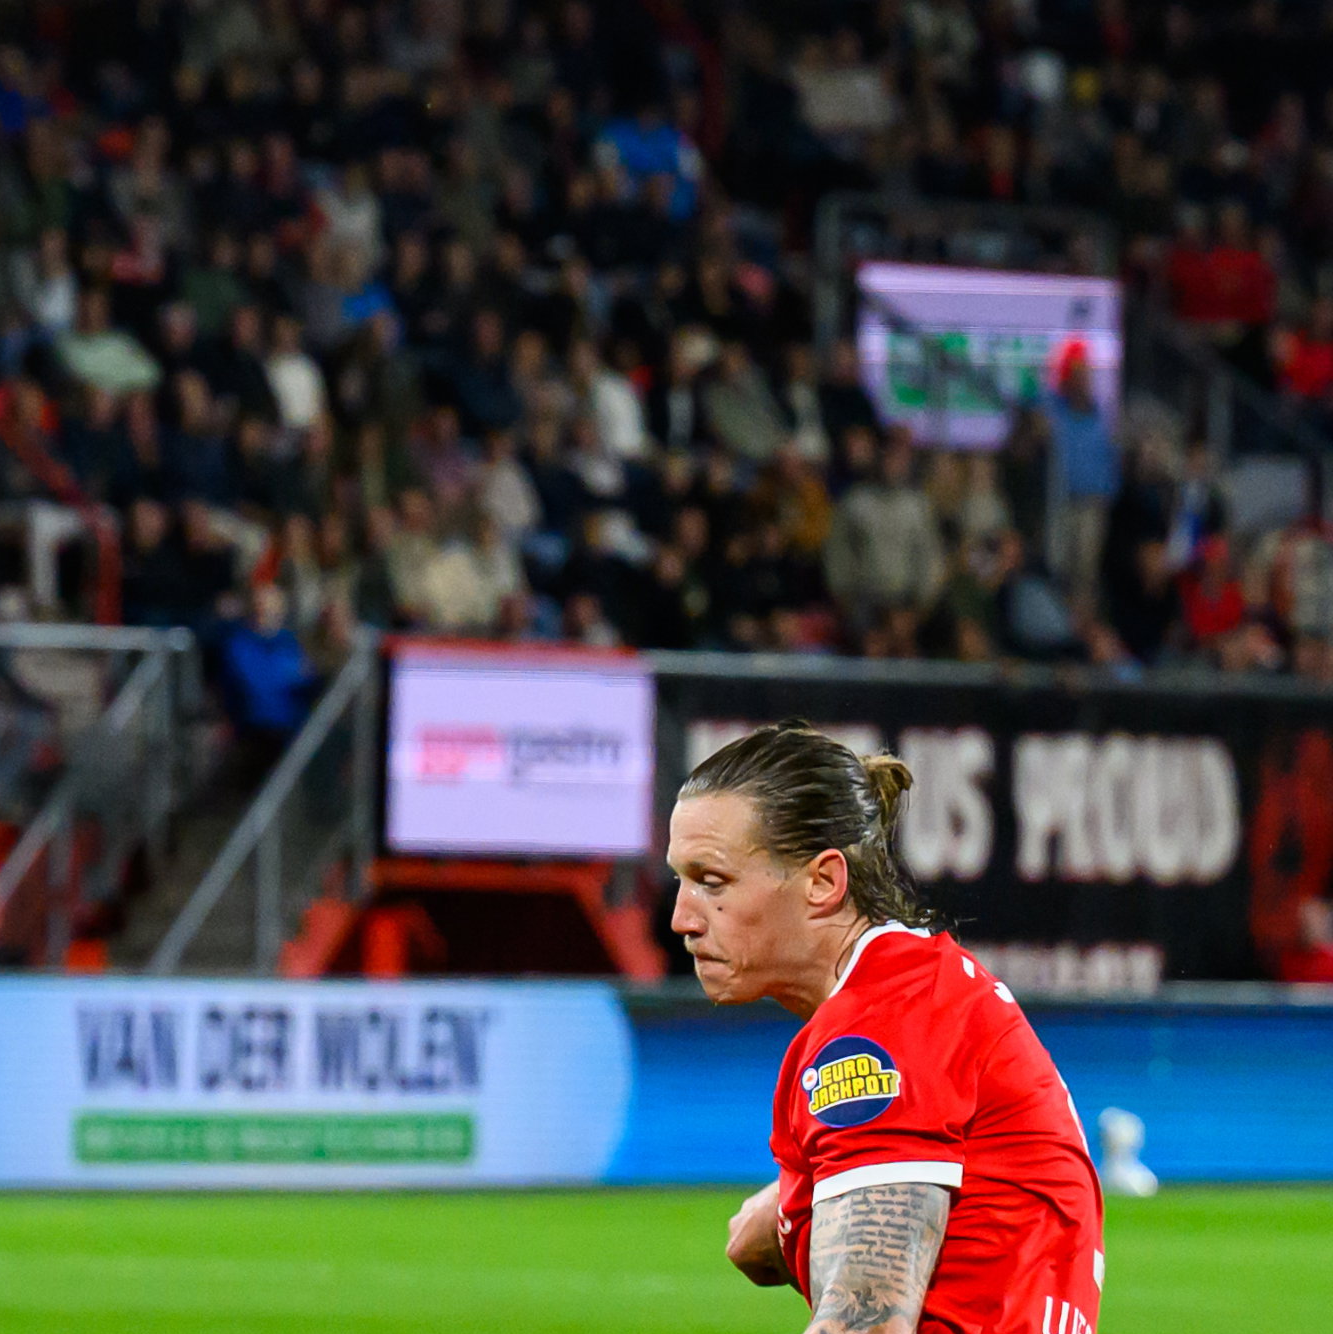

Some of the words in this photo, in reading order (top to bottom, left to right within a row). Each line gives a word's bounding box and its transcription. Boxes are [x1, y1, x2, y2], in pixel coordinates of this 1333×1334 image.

[76, 1008, 179, 1090] VAN
[821, 1056, 874, 1085] EURO
[811, 1073, 893, 1112] JACKPOT
